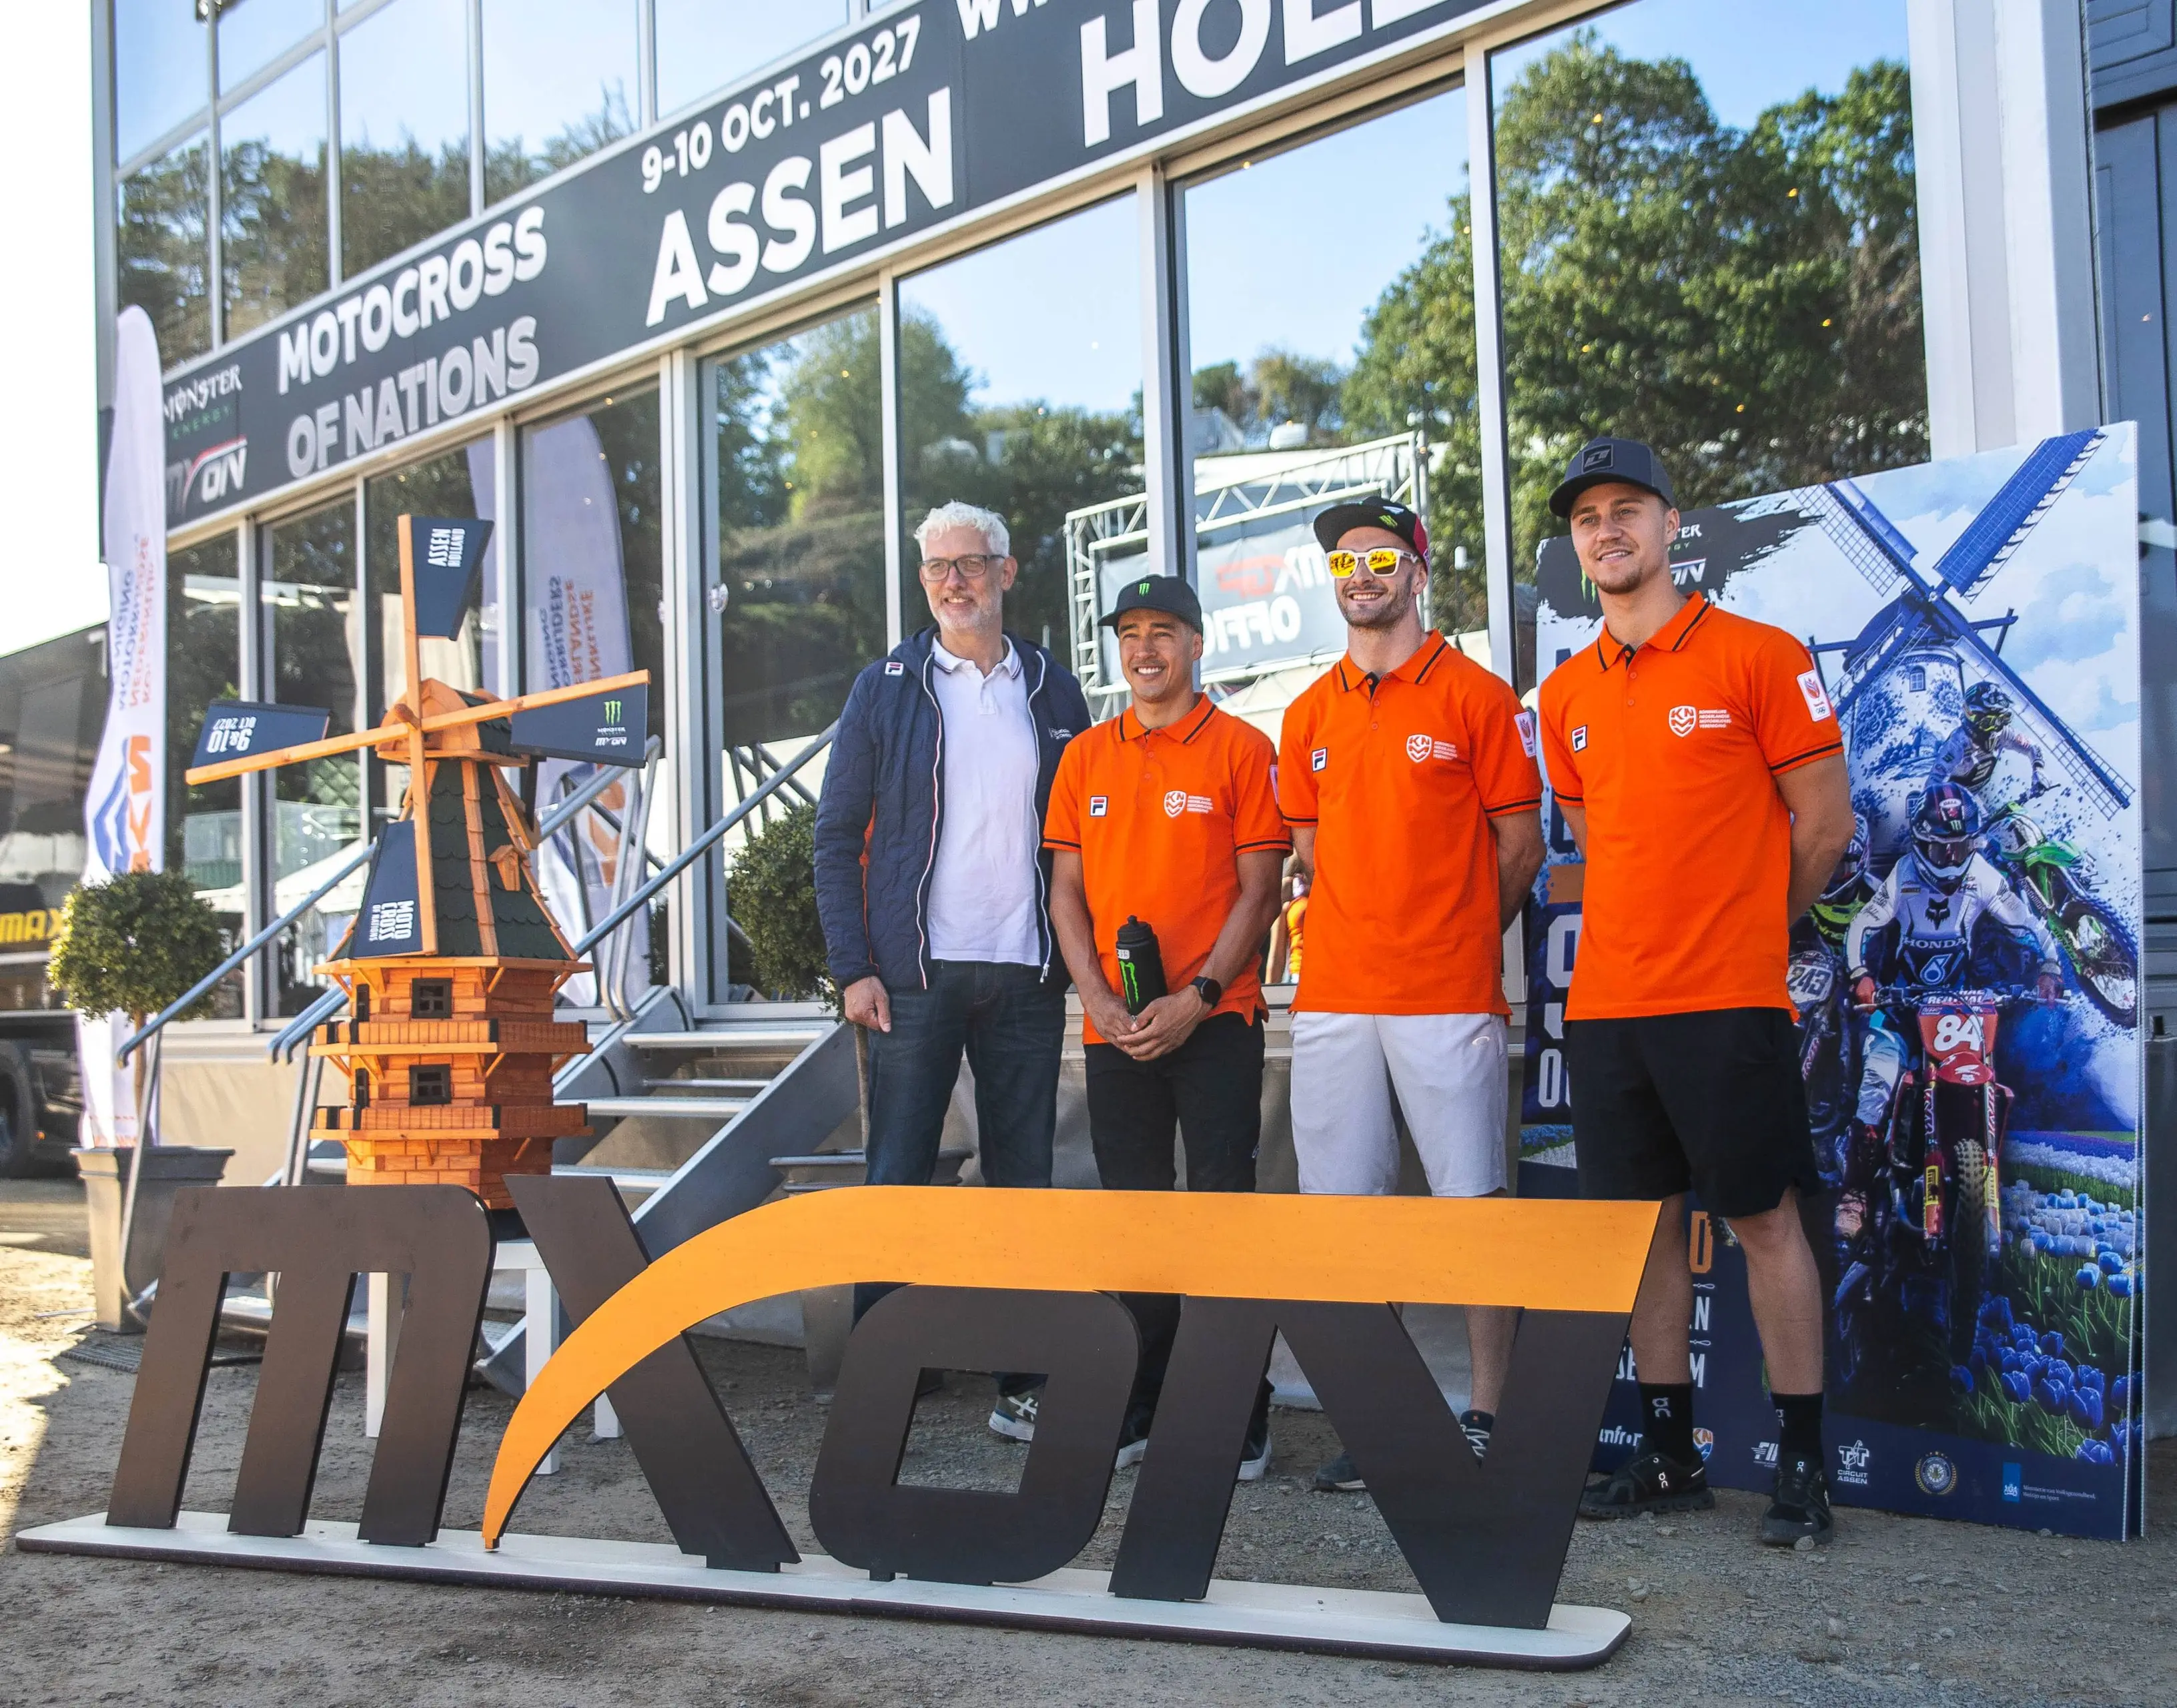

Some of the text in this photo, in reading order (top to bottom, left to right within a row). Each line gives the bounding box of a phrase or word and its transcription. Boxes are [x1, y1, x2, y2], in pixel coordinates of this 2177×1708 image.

[1079, 0, 1456, 148] HOL
[641, 14, 922, 193] 9-10 OCT. 2027
[645, 86, 955, 328] ASSEN
[278, 205, 547, 395] MOTOCROSS
[287, 315, 540, 479] OF NATIONS
[428, 528, 452, 567] ASSEN
[447, 528, 466, 568] HOLLAND
[213, 716, 257, 731] OCT 2027
[378, 902, 398, 941] CROSS
[394, 900, 414, 939] MOTO
[1903, 936, 1966, 949] HONDA
[1933, 1014, 1984, 1052] 84
[1836, 1475, 1867, 1484] ASSEN
[1837, 1469, 1868, 1478] CIRCUIT
